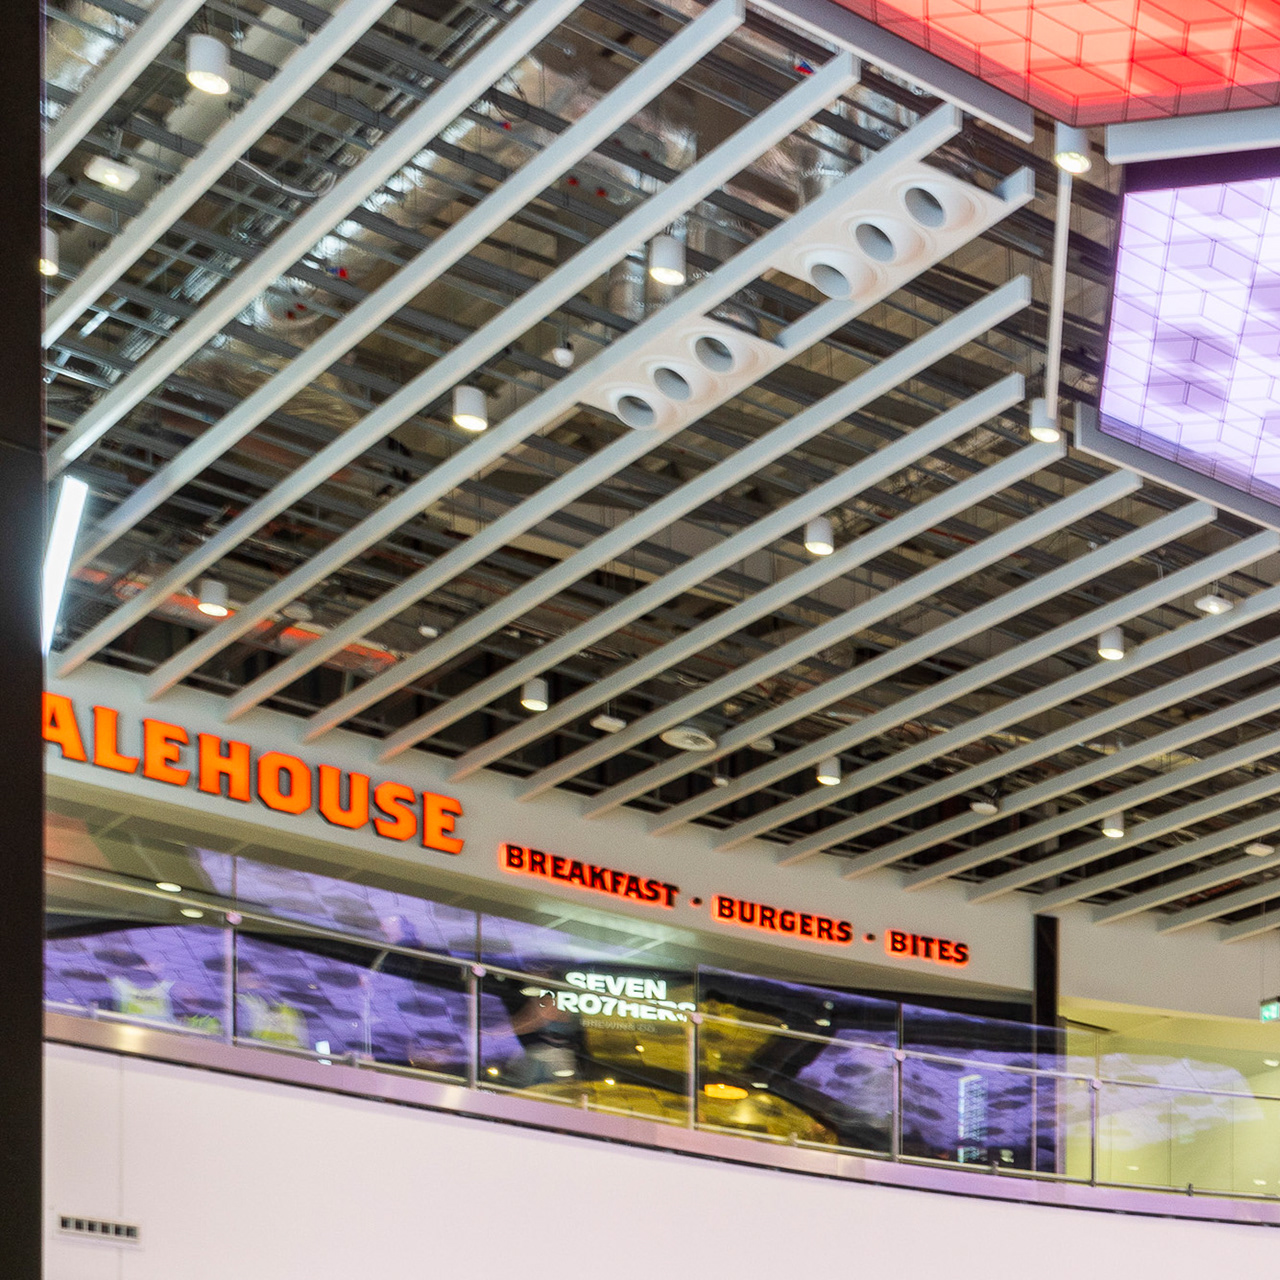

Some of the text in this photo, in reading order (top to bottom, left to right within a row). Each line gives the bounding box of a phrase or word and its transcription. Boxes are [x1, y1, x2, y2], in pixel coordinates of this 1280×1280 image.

[42, 691, 465, 856] ALEHOUSE
[501, 842, 970, 965] BREAKFAST BURGERS BITES
[565, 971, 667, 1000] SEVEN
